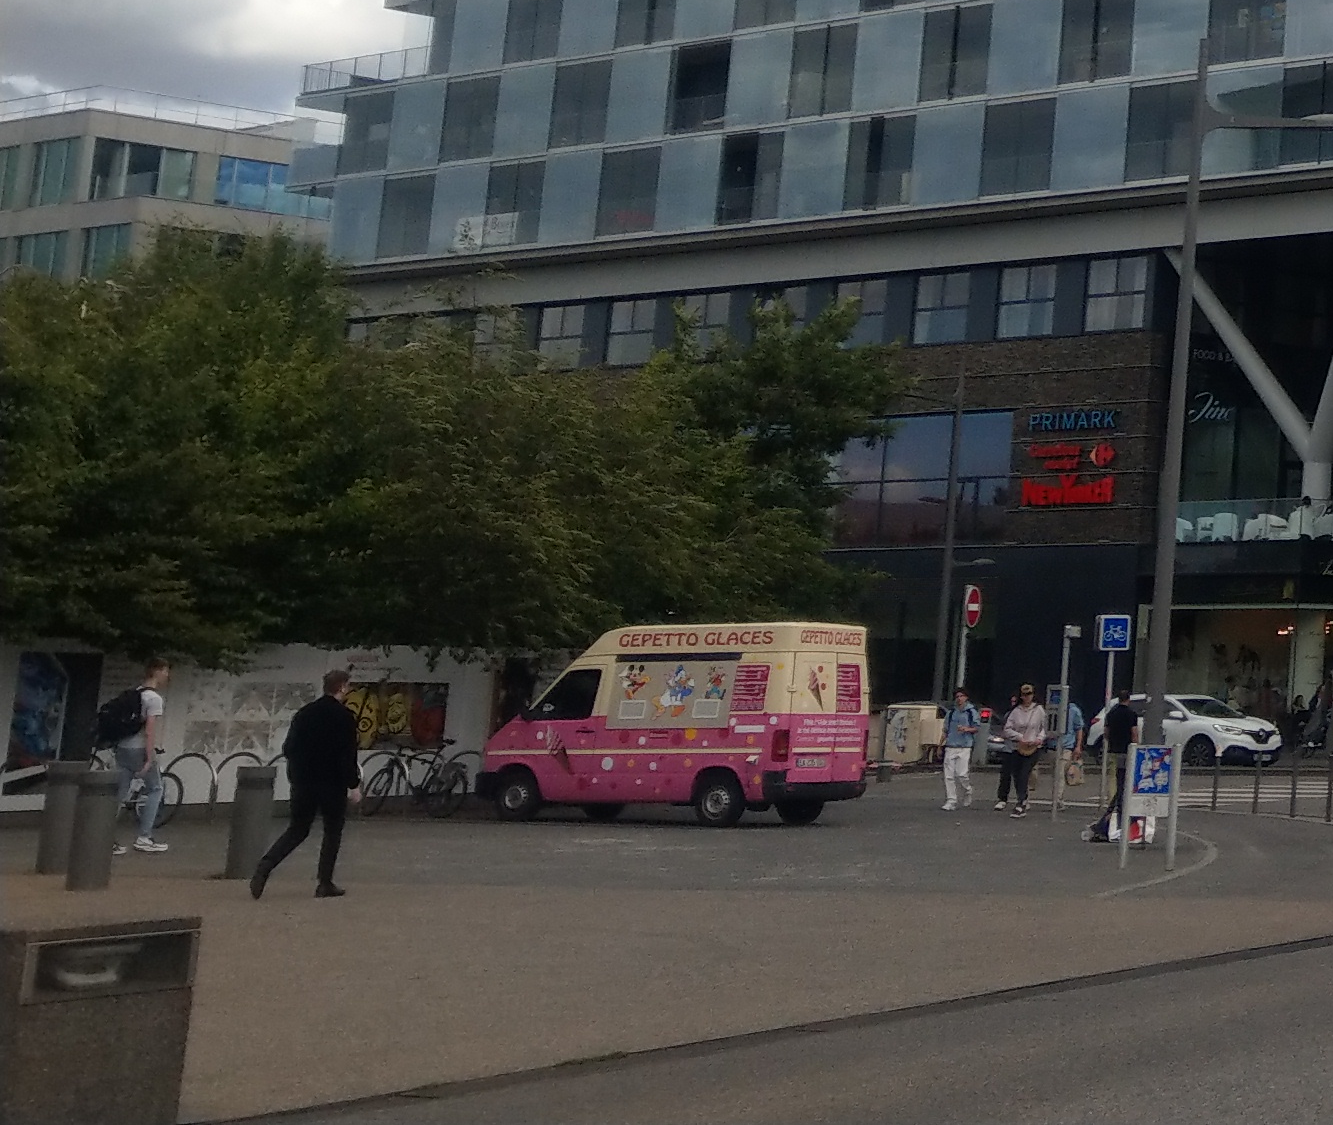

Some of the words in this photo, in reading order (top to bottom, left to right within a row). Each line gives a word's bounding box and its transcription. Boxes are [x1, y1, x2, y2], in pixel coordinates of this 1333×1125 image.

[1028, 409, 1116, 432] PRIMARK
[619, 632, 699, 648] GEPETTO
[703, 630, 775, 645] GLACES
[800, 629, 834, 646] GEPETTO
[834, 631, 863, 647] GLACES
